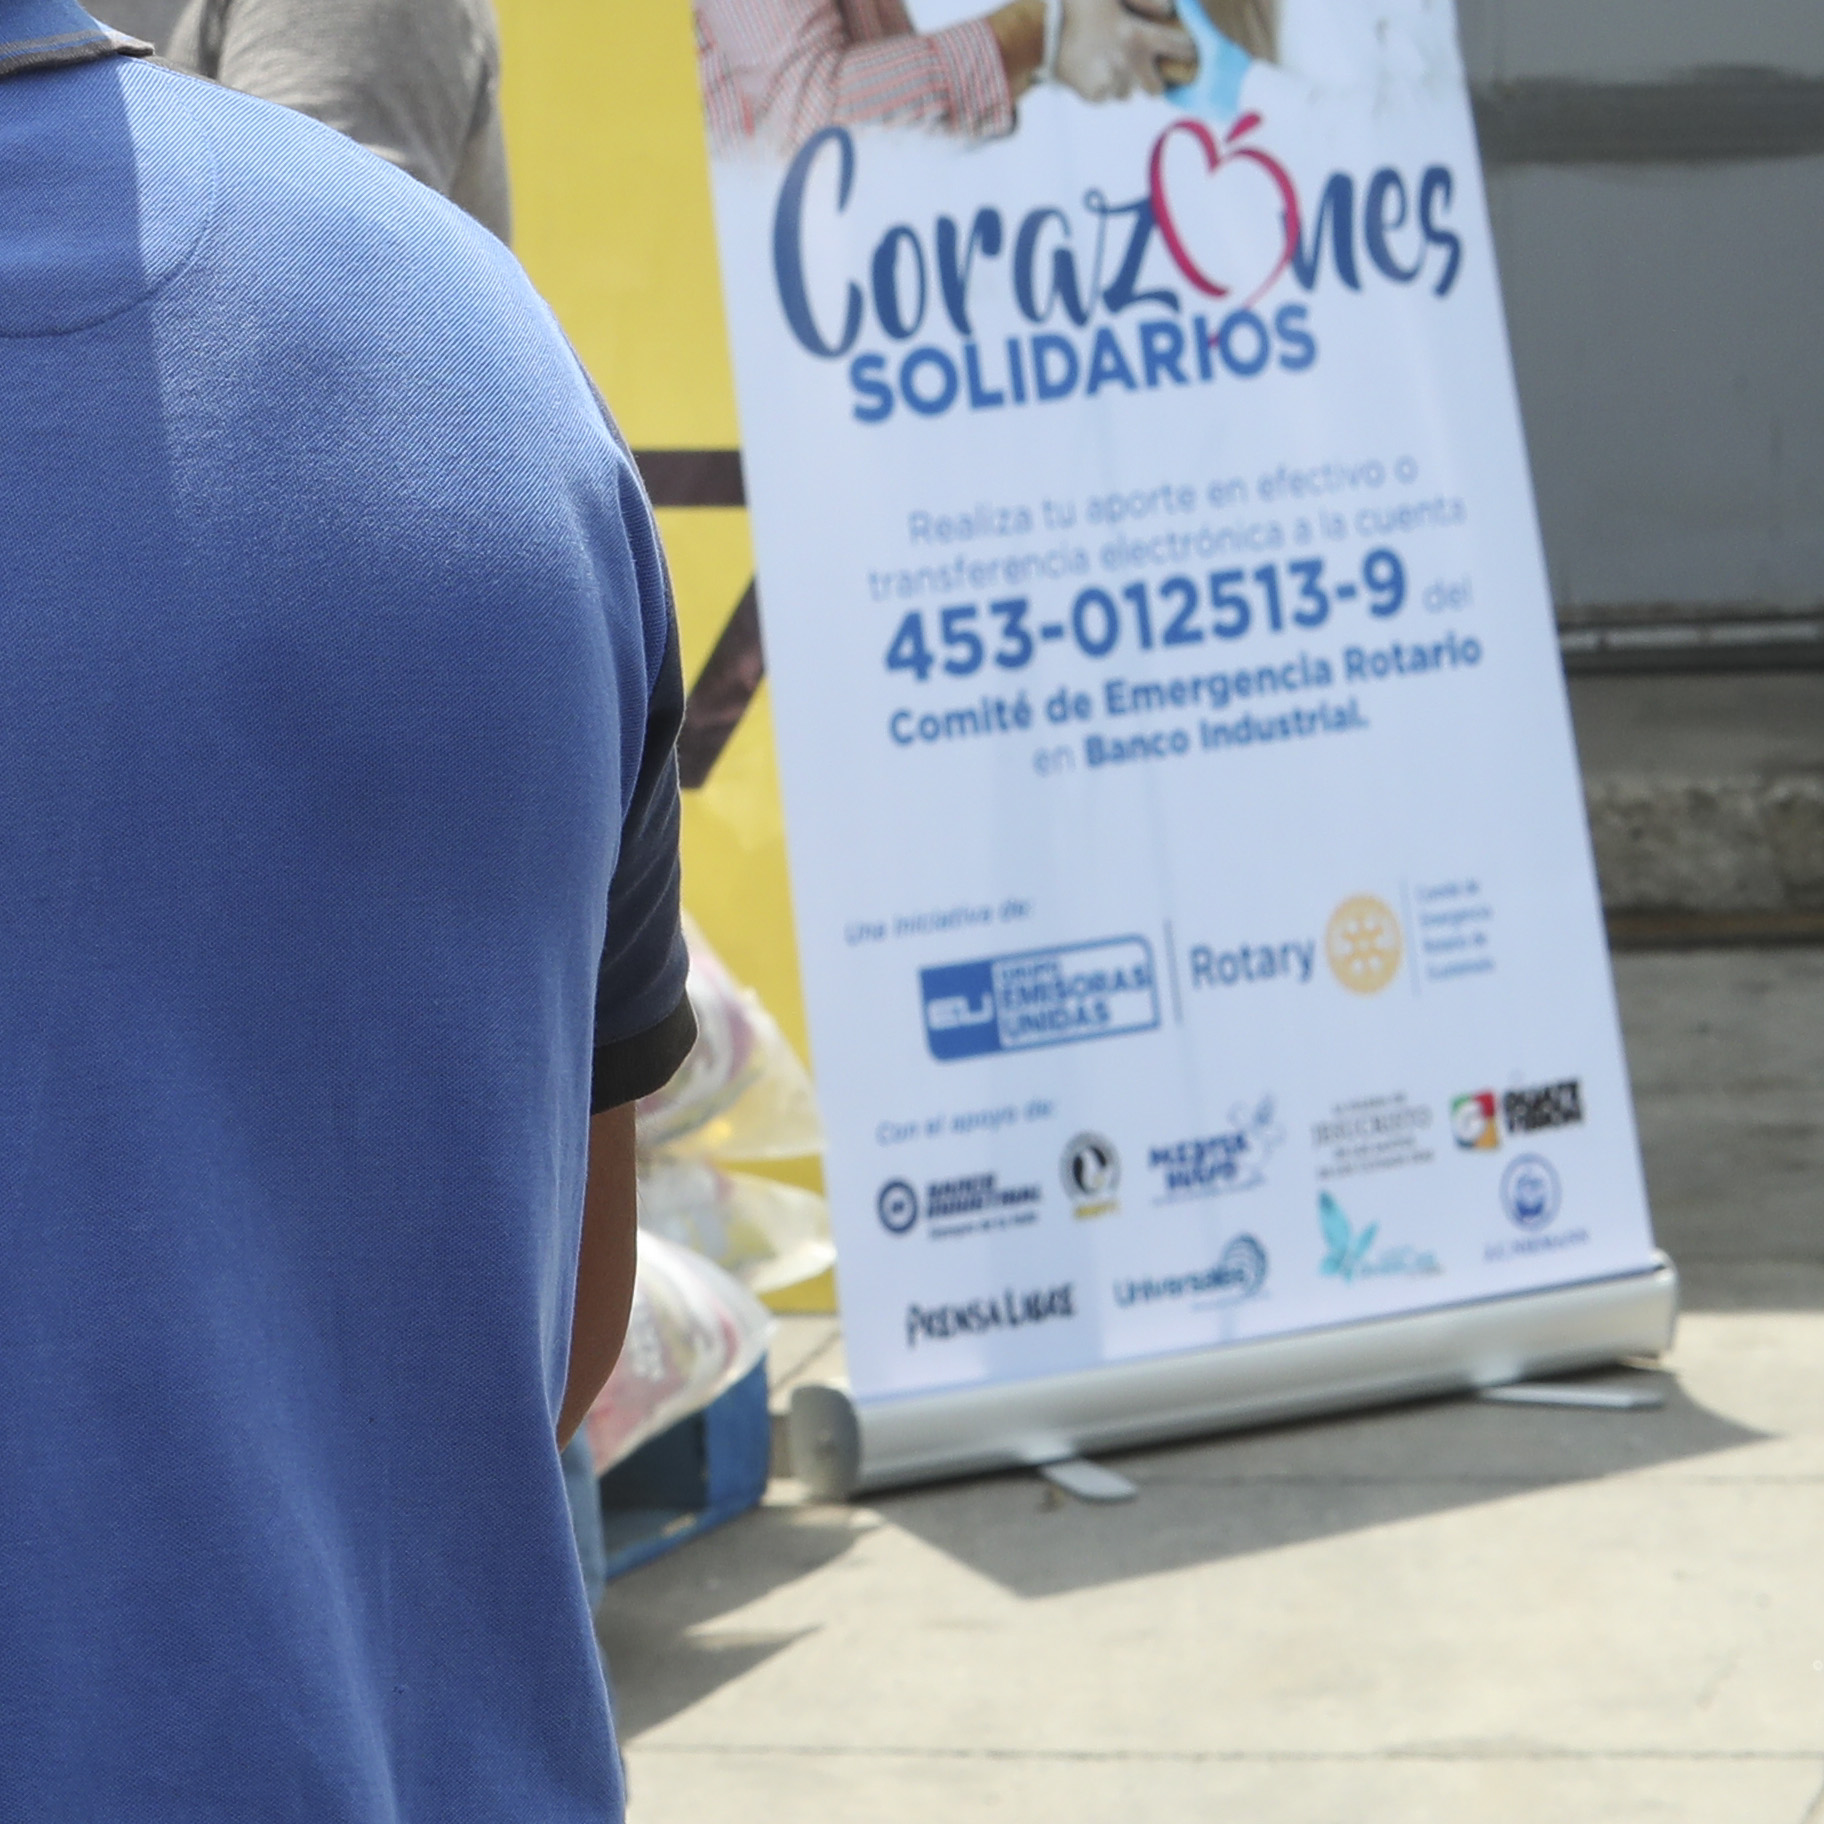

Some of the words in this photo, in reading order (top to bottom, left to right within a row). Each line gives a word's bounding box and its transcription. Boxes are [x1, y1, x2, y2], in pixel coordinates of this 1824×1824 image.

[849, 302, 1318, 424] SOLIDARIOS
[907, 498, 1034, 546] Realiza
[1042, 496, 1077, 530] tu
[1086, 482, 1198, 527] aporte
[1206, 478, 1249, 509] en
[1256, 458, 1387, 503] efectivo
[1393, 454, 1419, 486] o
[866, 542, 1091, 602] transferencia
[1098, 518, 1285, 572] electrónica
[1292, 515, 1314, 547] a
[1317, 507, 1348, 542] la
[1353, 495, 1468, 536] cuenta
[884, 545, 1409, 682] 453-012513-9
[1421, 571, 1474, 614] del
[888, 687, 1033, 748] Comité
[1044, 684, 1093, 725] de
[1104, 650, 1333, 717] Emergencia
[1343, 629, 1483, 682] Rotario
[1031, 744, 1076, 777] en
[1084, 728, 1190, 769] Banco
[1199, 694, 1371, 752] Industrial.
[1002, 964, 1150, 1006] EMISORAS
[1188, 937, 1317, 990] Rotary
[1003, 1000, 1111, 1038] UNIDAS
